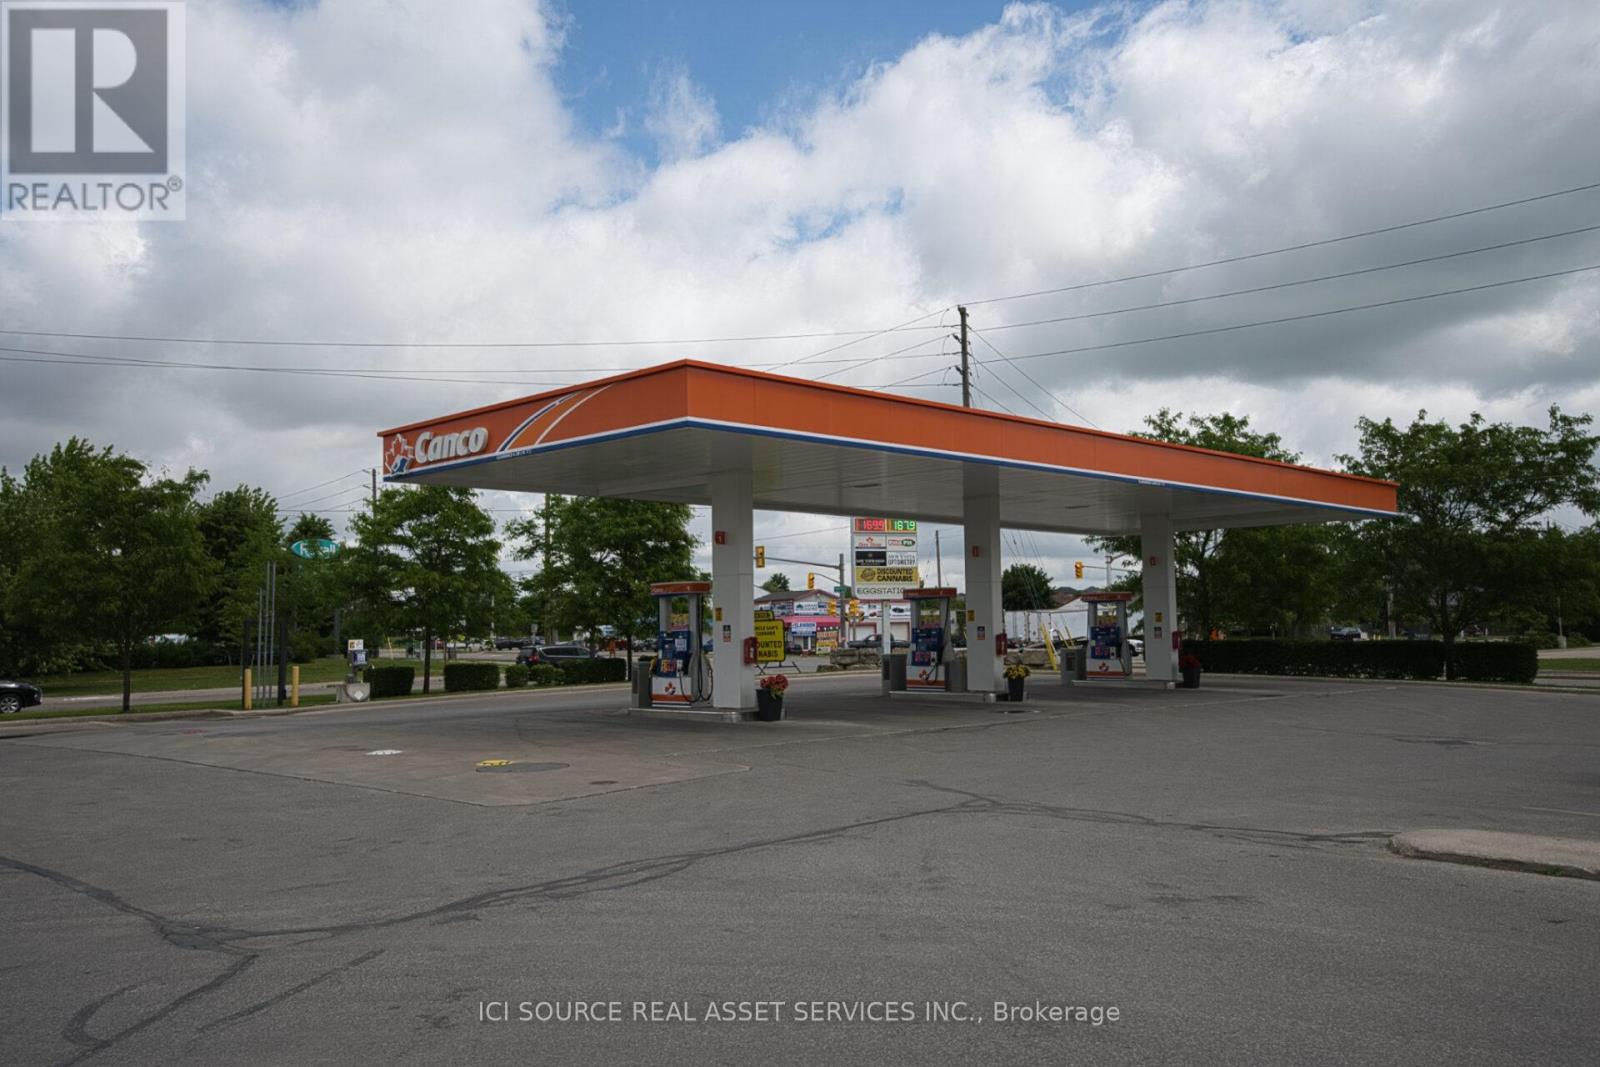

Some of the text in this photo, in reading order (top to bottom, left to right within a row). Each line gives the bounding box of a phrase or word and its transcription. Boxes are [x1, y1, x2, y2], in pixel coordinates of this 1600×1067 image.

[415, 427, 488, 464] Canco
[877, 567, 913, 575] DISCOUNTED
[757, 640, 782, 648] OUNTED
